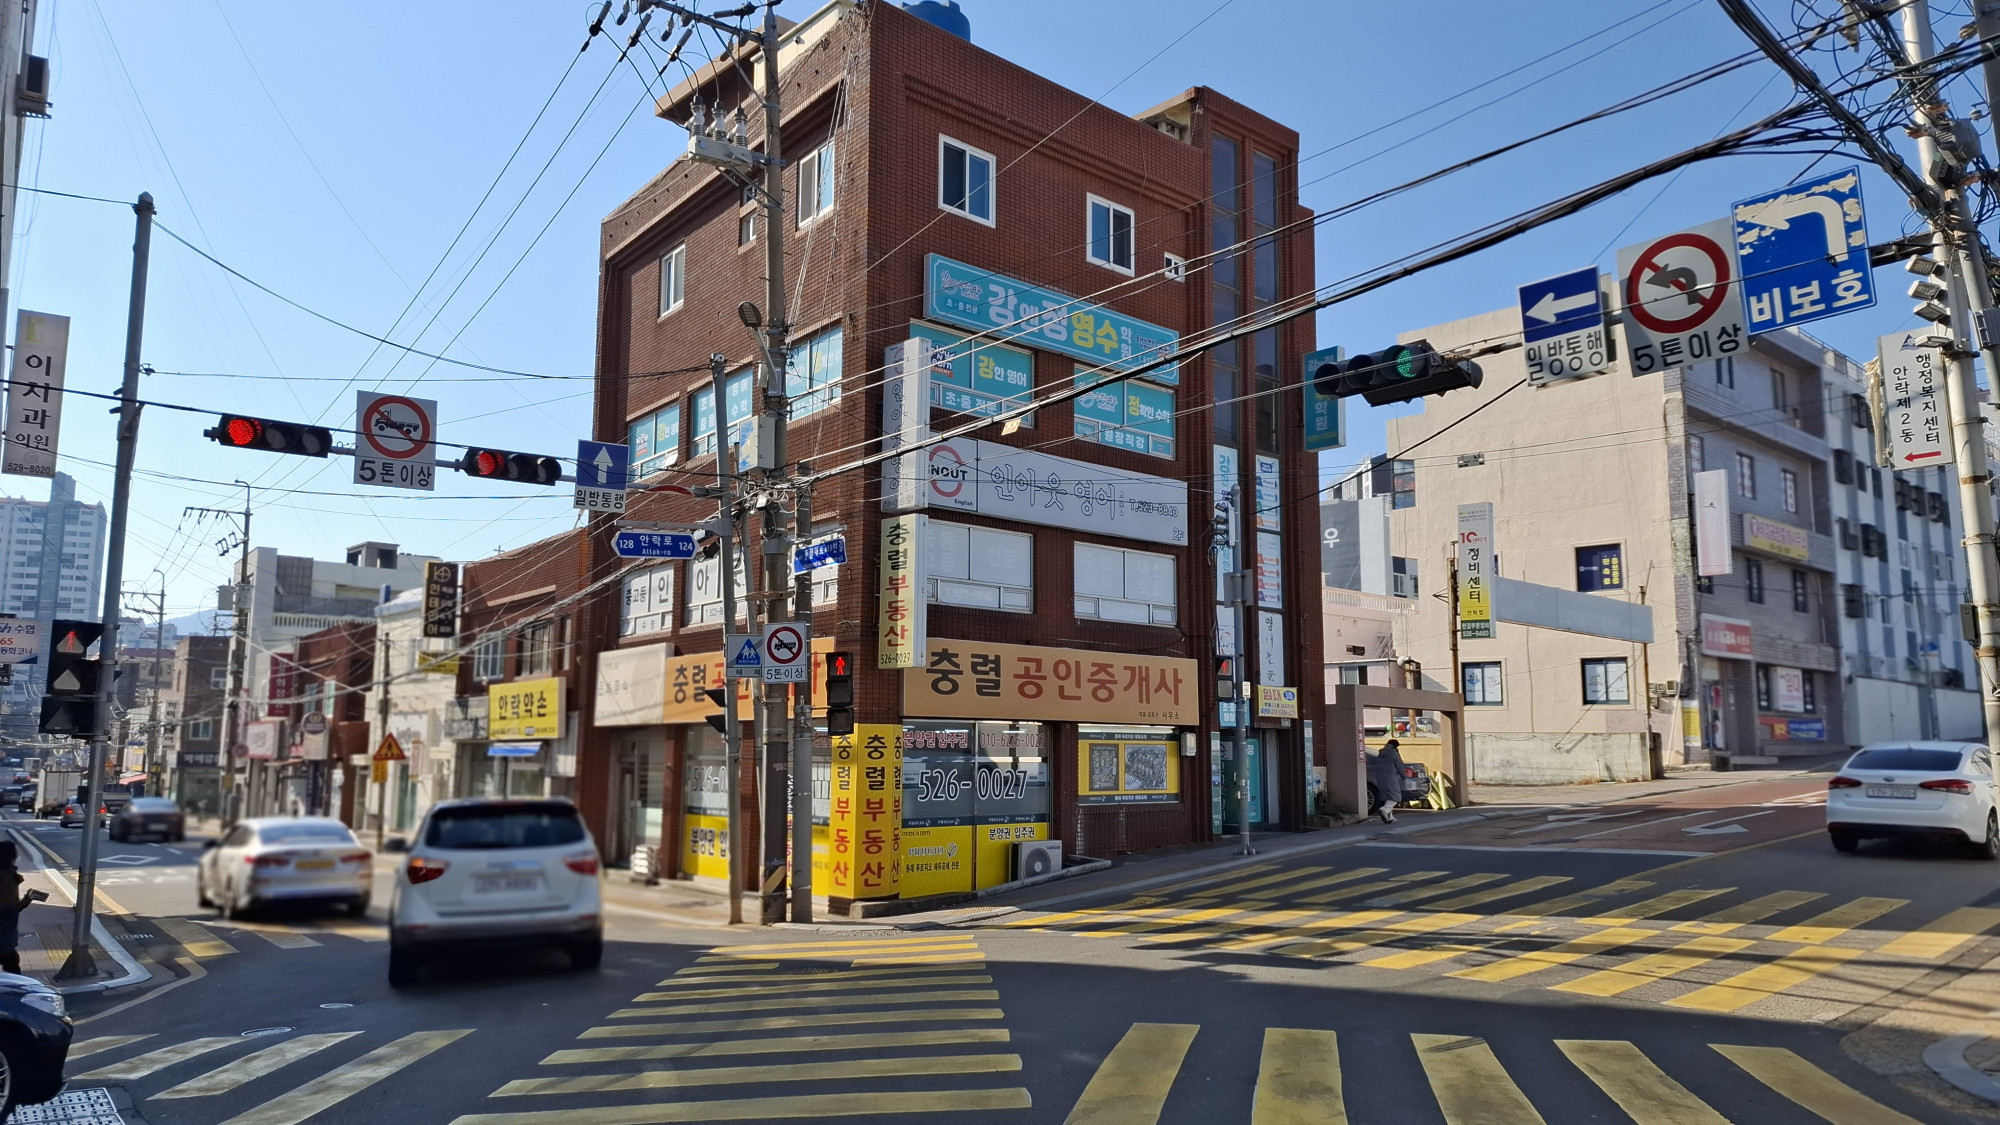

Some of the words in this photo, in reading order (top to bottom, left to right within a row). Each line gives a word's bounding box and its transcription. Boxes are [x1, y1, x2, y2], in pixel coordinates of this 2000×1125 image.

[1749, 268, 1869, 325] 비보호
[1527, 330, 1604, 382] 일방통행
[1633, 323, 1741, 373] 5톤이상
[978, 355, 1005, 381] 강한
[1007, 369, 1027, 387] 영어
[20, 354, 52, 431] 이치과
[1893, 365, 1915, 444] 안락제2동
[1915, 352, 1940, 444] 행정복지센터
[1105, 430, 1145, 449] 원장직강
[8, 463, 51, 476] 529-8020
[359, 459, 432, 488] 5톤이상
[575, 488, 625, 510] 일방통행
[955, 498, 973, 507] English
[991, 463, 1067, 511] 인아웃
[1074, 477, 1116, 521] 영어
[1129, 498, 1178, 518] T.523-8840
[619, 539, 634, 549] 128
[639, 535, 673, 547] 안락로
[679, 542, 693, 551] 124
[1173, 527, 1184, 541] 2F
[642, 548, 671, 557] Allak-ro
[697, 565, 710, 595] 아
[884, 523, 910, 648] 충렬부동산
[1467, 548, 1481, 603] 정비센터
[658, 574, 669, 604] 인
[881, 653, 911, 664] 526-0027
[926, 648, 1001, 698] 충렬
[1013, 656, 1183, 706] 공인중개사
[1263, 688, 1281, 701] 임대
[1161, 711, 1180, 720] 사무소
[903, 730, 936, 750] 분양권
[937, 730, 968, 750] 입주권
[833, 735, 853, 888] 충렬부동산
[860, 734, 888, 889] 충렬부동산
[988, 828, 1011, 841] 분양권
[1014, 826, 1035, 840] 입주권
